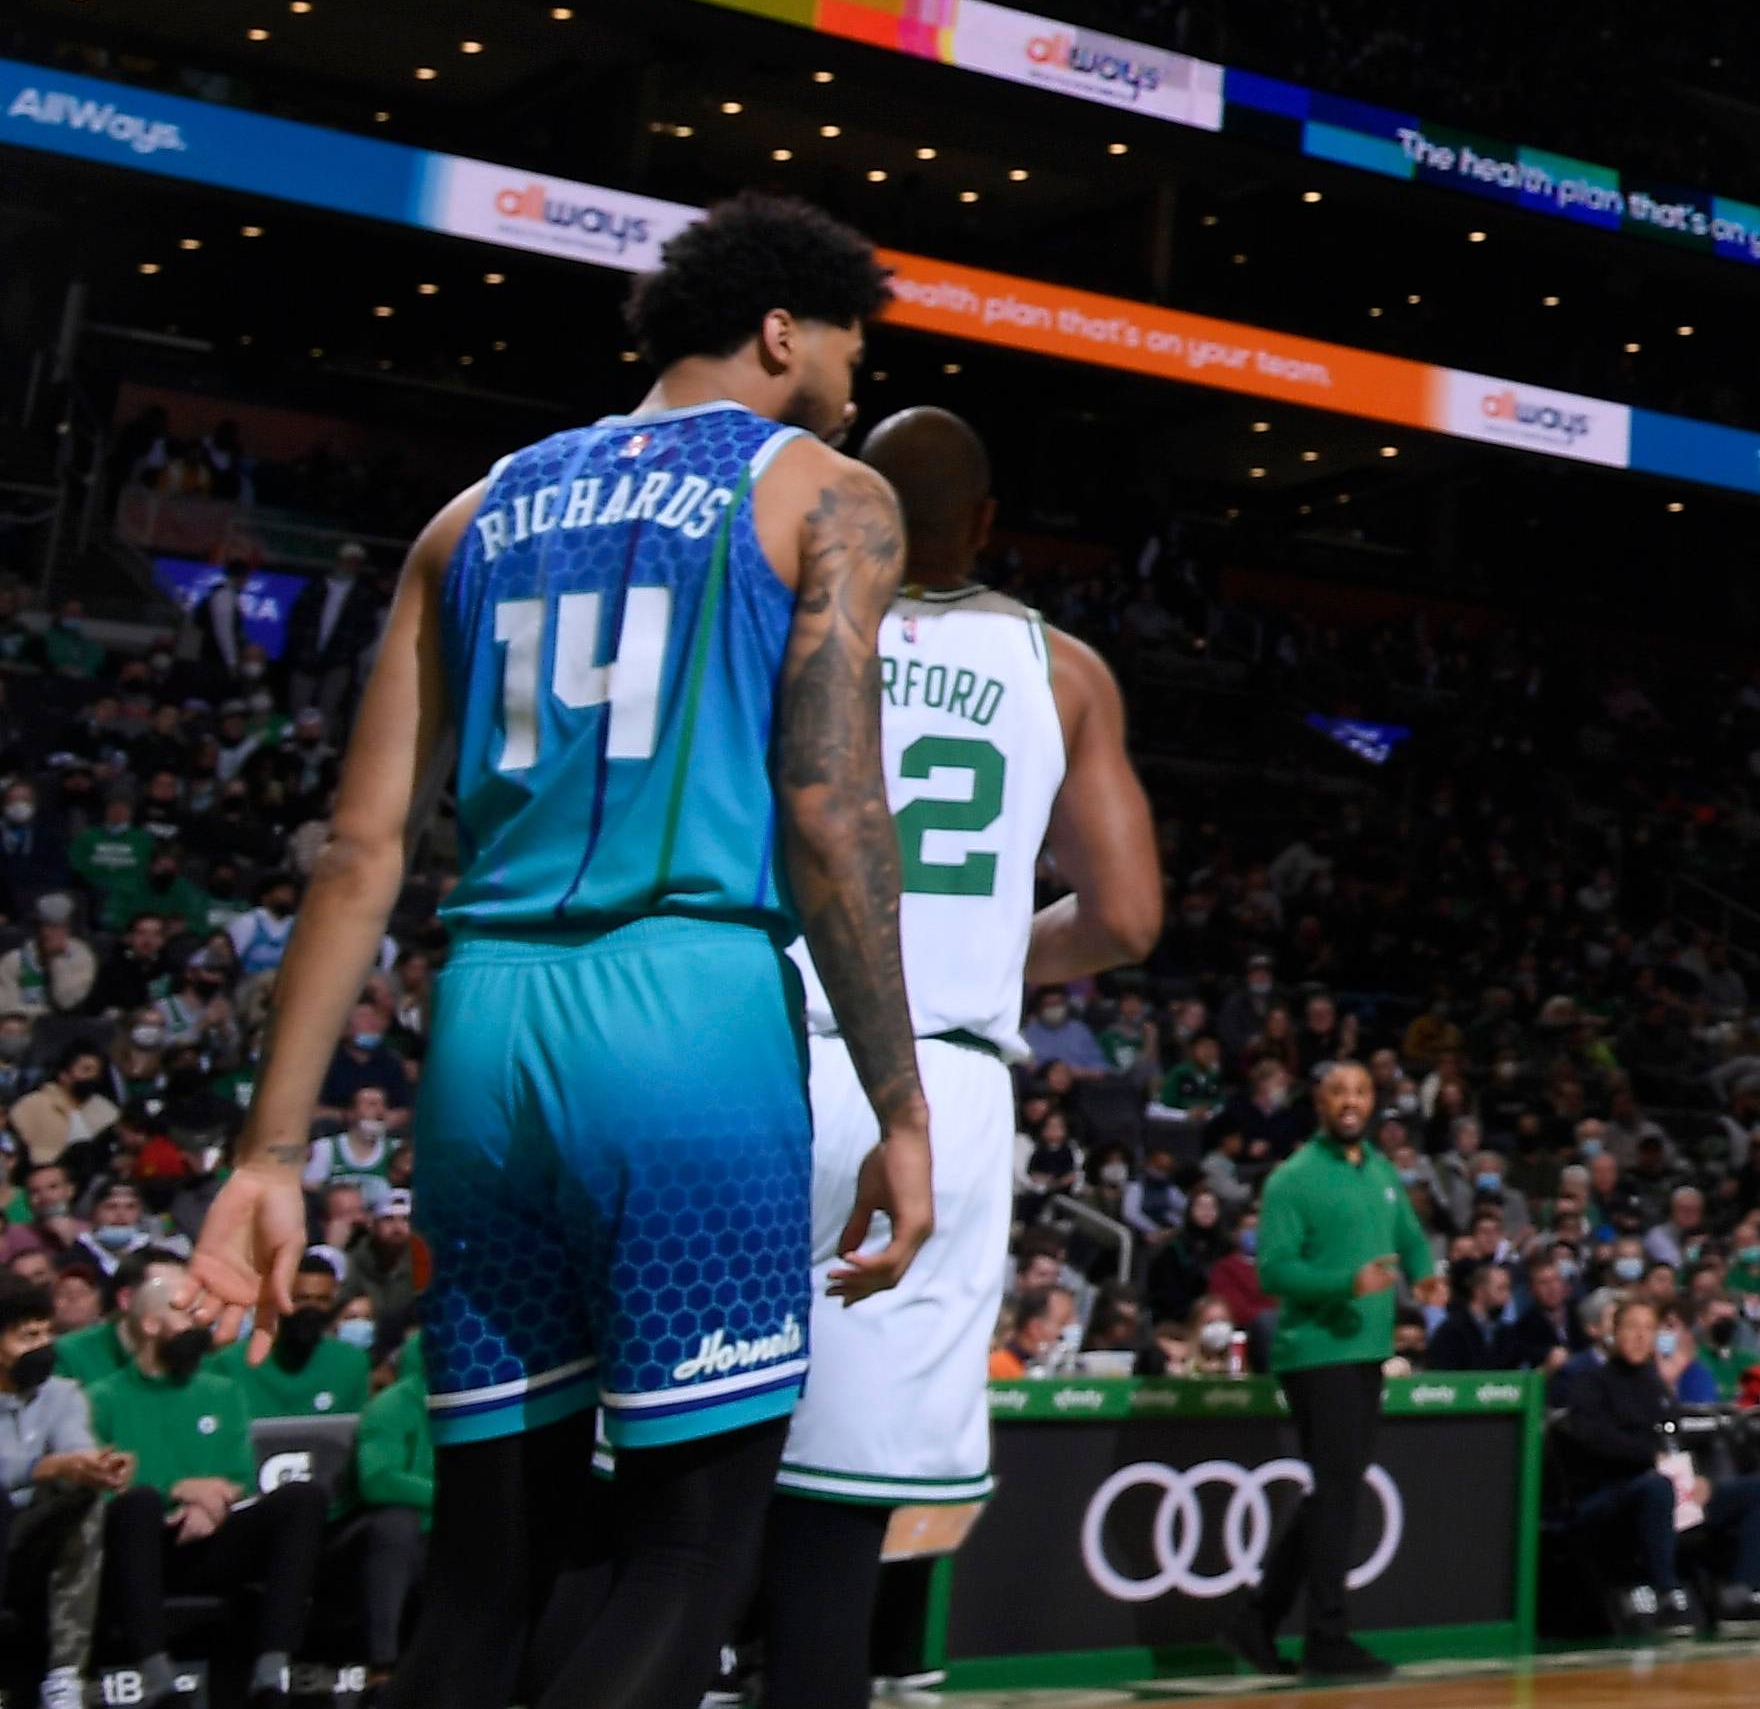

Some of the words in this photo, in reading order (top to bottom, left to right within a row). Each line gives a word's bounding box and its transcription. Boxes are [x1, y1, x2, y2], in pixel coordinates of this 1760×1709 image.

[496, 184, 649, 254] allways
[1398, 128, 1455, 171] The
[1459, 147, 1554, 196] health
[1557, 178, 1622, 214] plan
[1626, 191, 1708, 236] that's
[1710, 217, 1745, 245] on
[984, 294, 1053, 328] plan
[1057, 308, 1140, 349] that's
[1145, 328, 1182, 355] on
[1186, 337, 1251, 370] your
[1483, 390, 1589, 446] allways
[477, 469, 735, 560] RICHARDS
[494, 586, 673, 772] 14
[881, 655, 1005, 727] RFORD
[893, 735, 1007, 897] 2
[673, 1314, 802, 1382] Hornets
